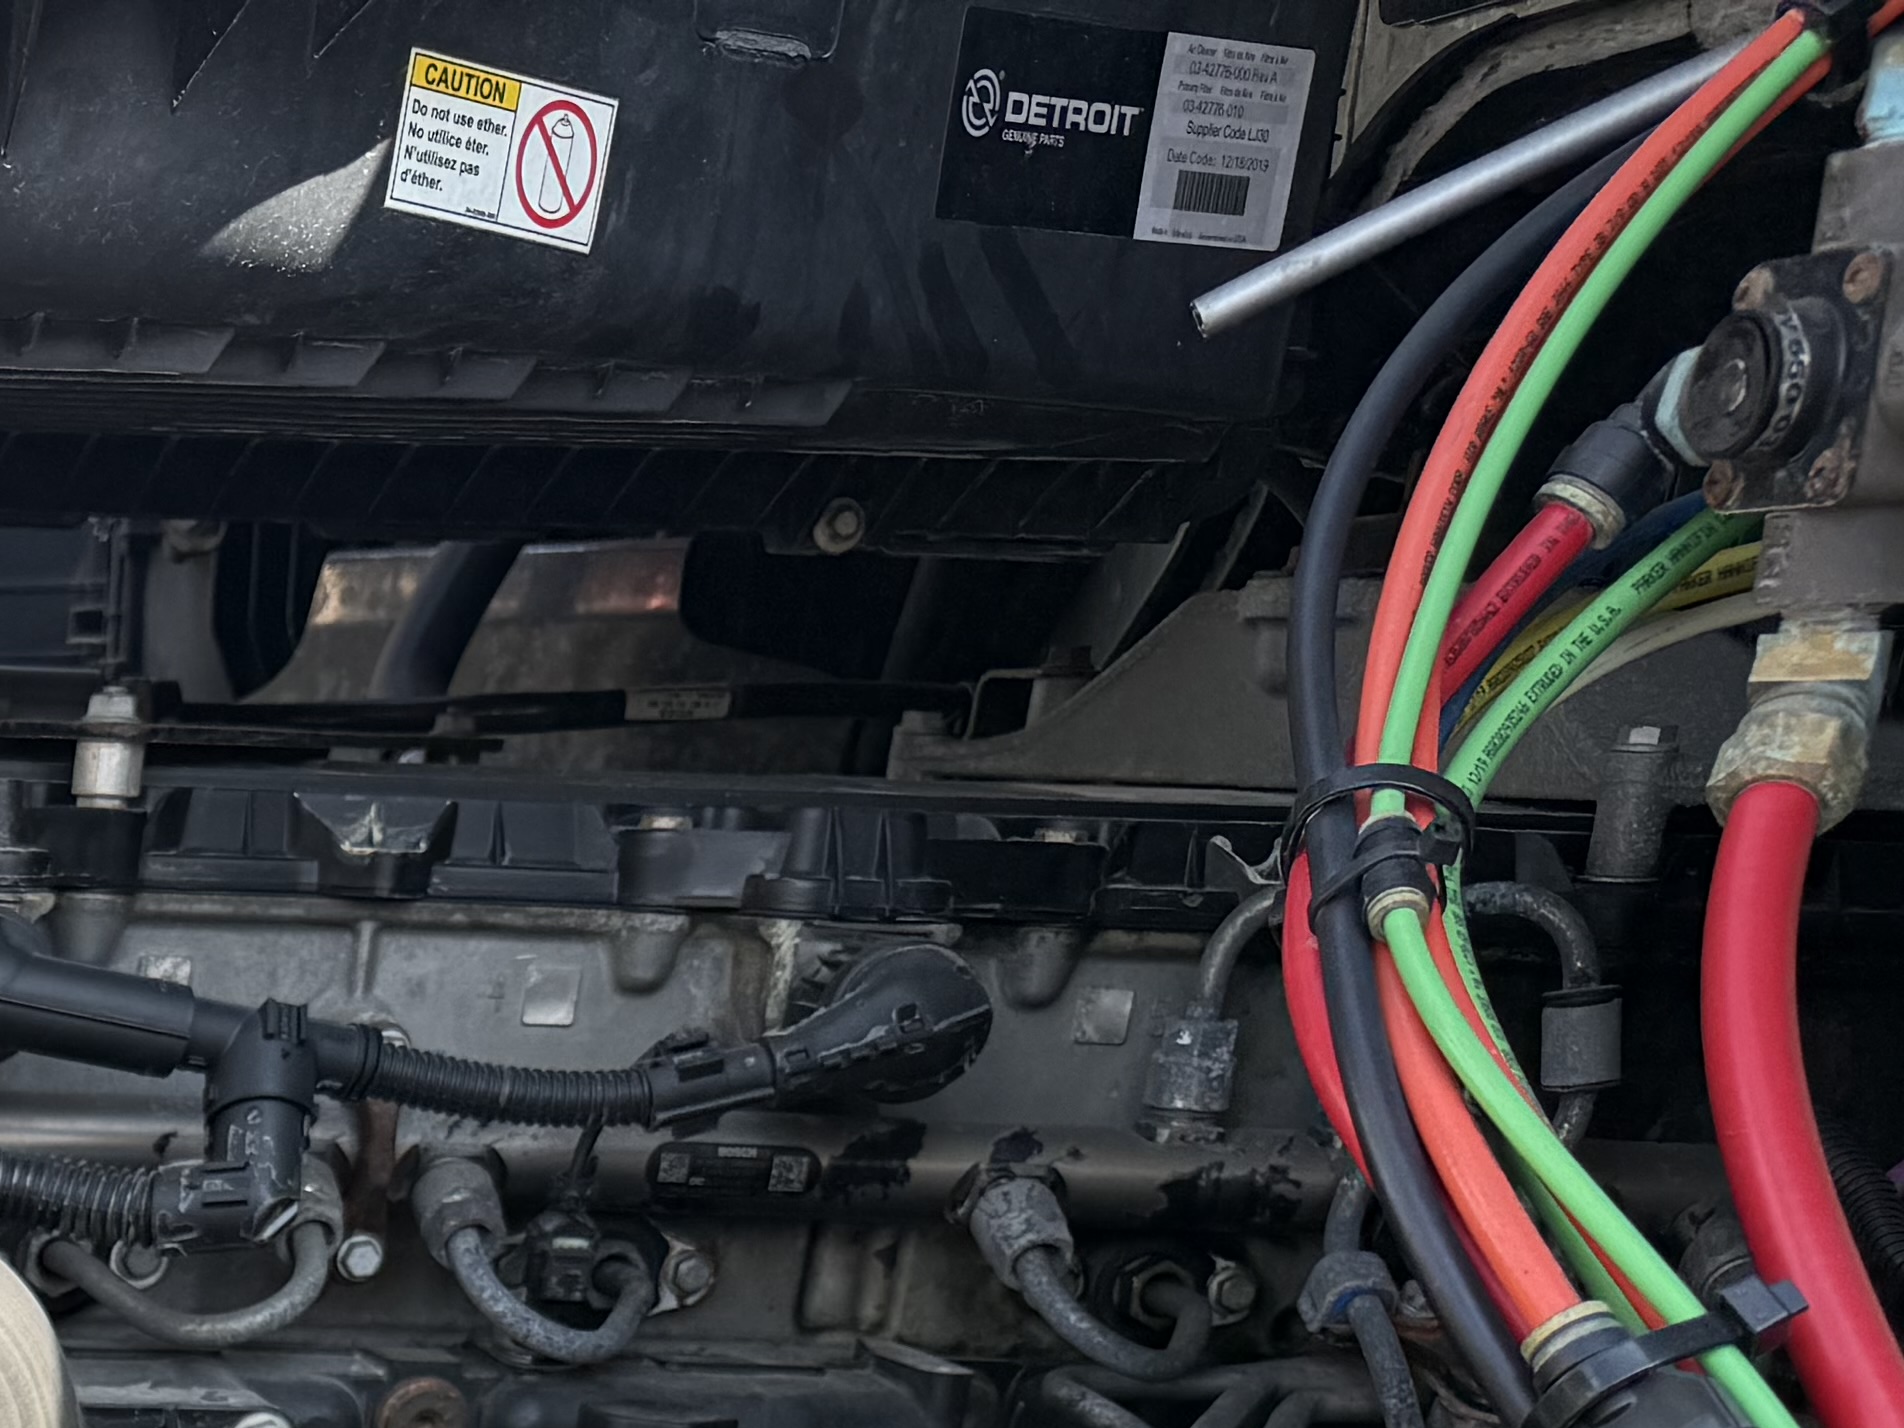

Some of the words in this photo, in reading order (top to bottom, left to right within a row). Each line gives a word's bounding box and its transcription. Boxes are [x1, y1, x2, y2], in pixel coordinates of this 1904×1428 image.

[424, 62, 506, 104] CAUTION
[412, 98, 428, 117] Do
[431, 105, 450, 122] not
[453, 113, 474, 128] use
[477, 117, 508, 137] ether.
[1004, 91, 1140, 136] DETROIT
[1186, 120, 1222, 138] Supplier
[1223, 124, 1246, 140] Code
[408, 122, 424, 138] No
[428, 128, 462, 149] utilice
[465, 134, 490, 156] éter.
[404, 144, 457, 171] N'utilisez
[459, 161, 480, 177] pas
[1167, 148, 1188, 164] Date
[1189, 151, 1216, 166] Code:
[1562, 648, 1577, 665] IN
[1572, 630, 1593, 652] THE
